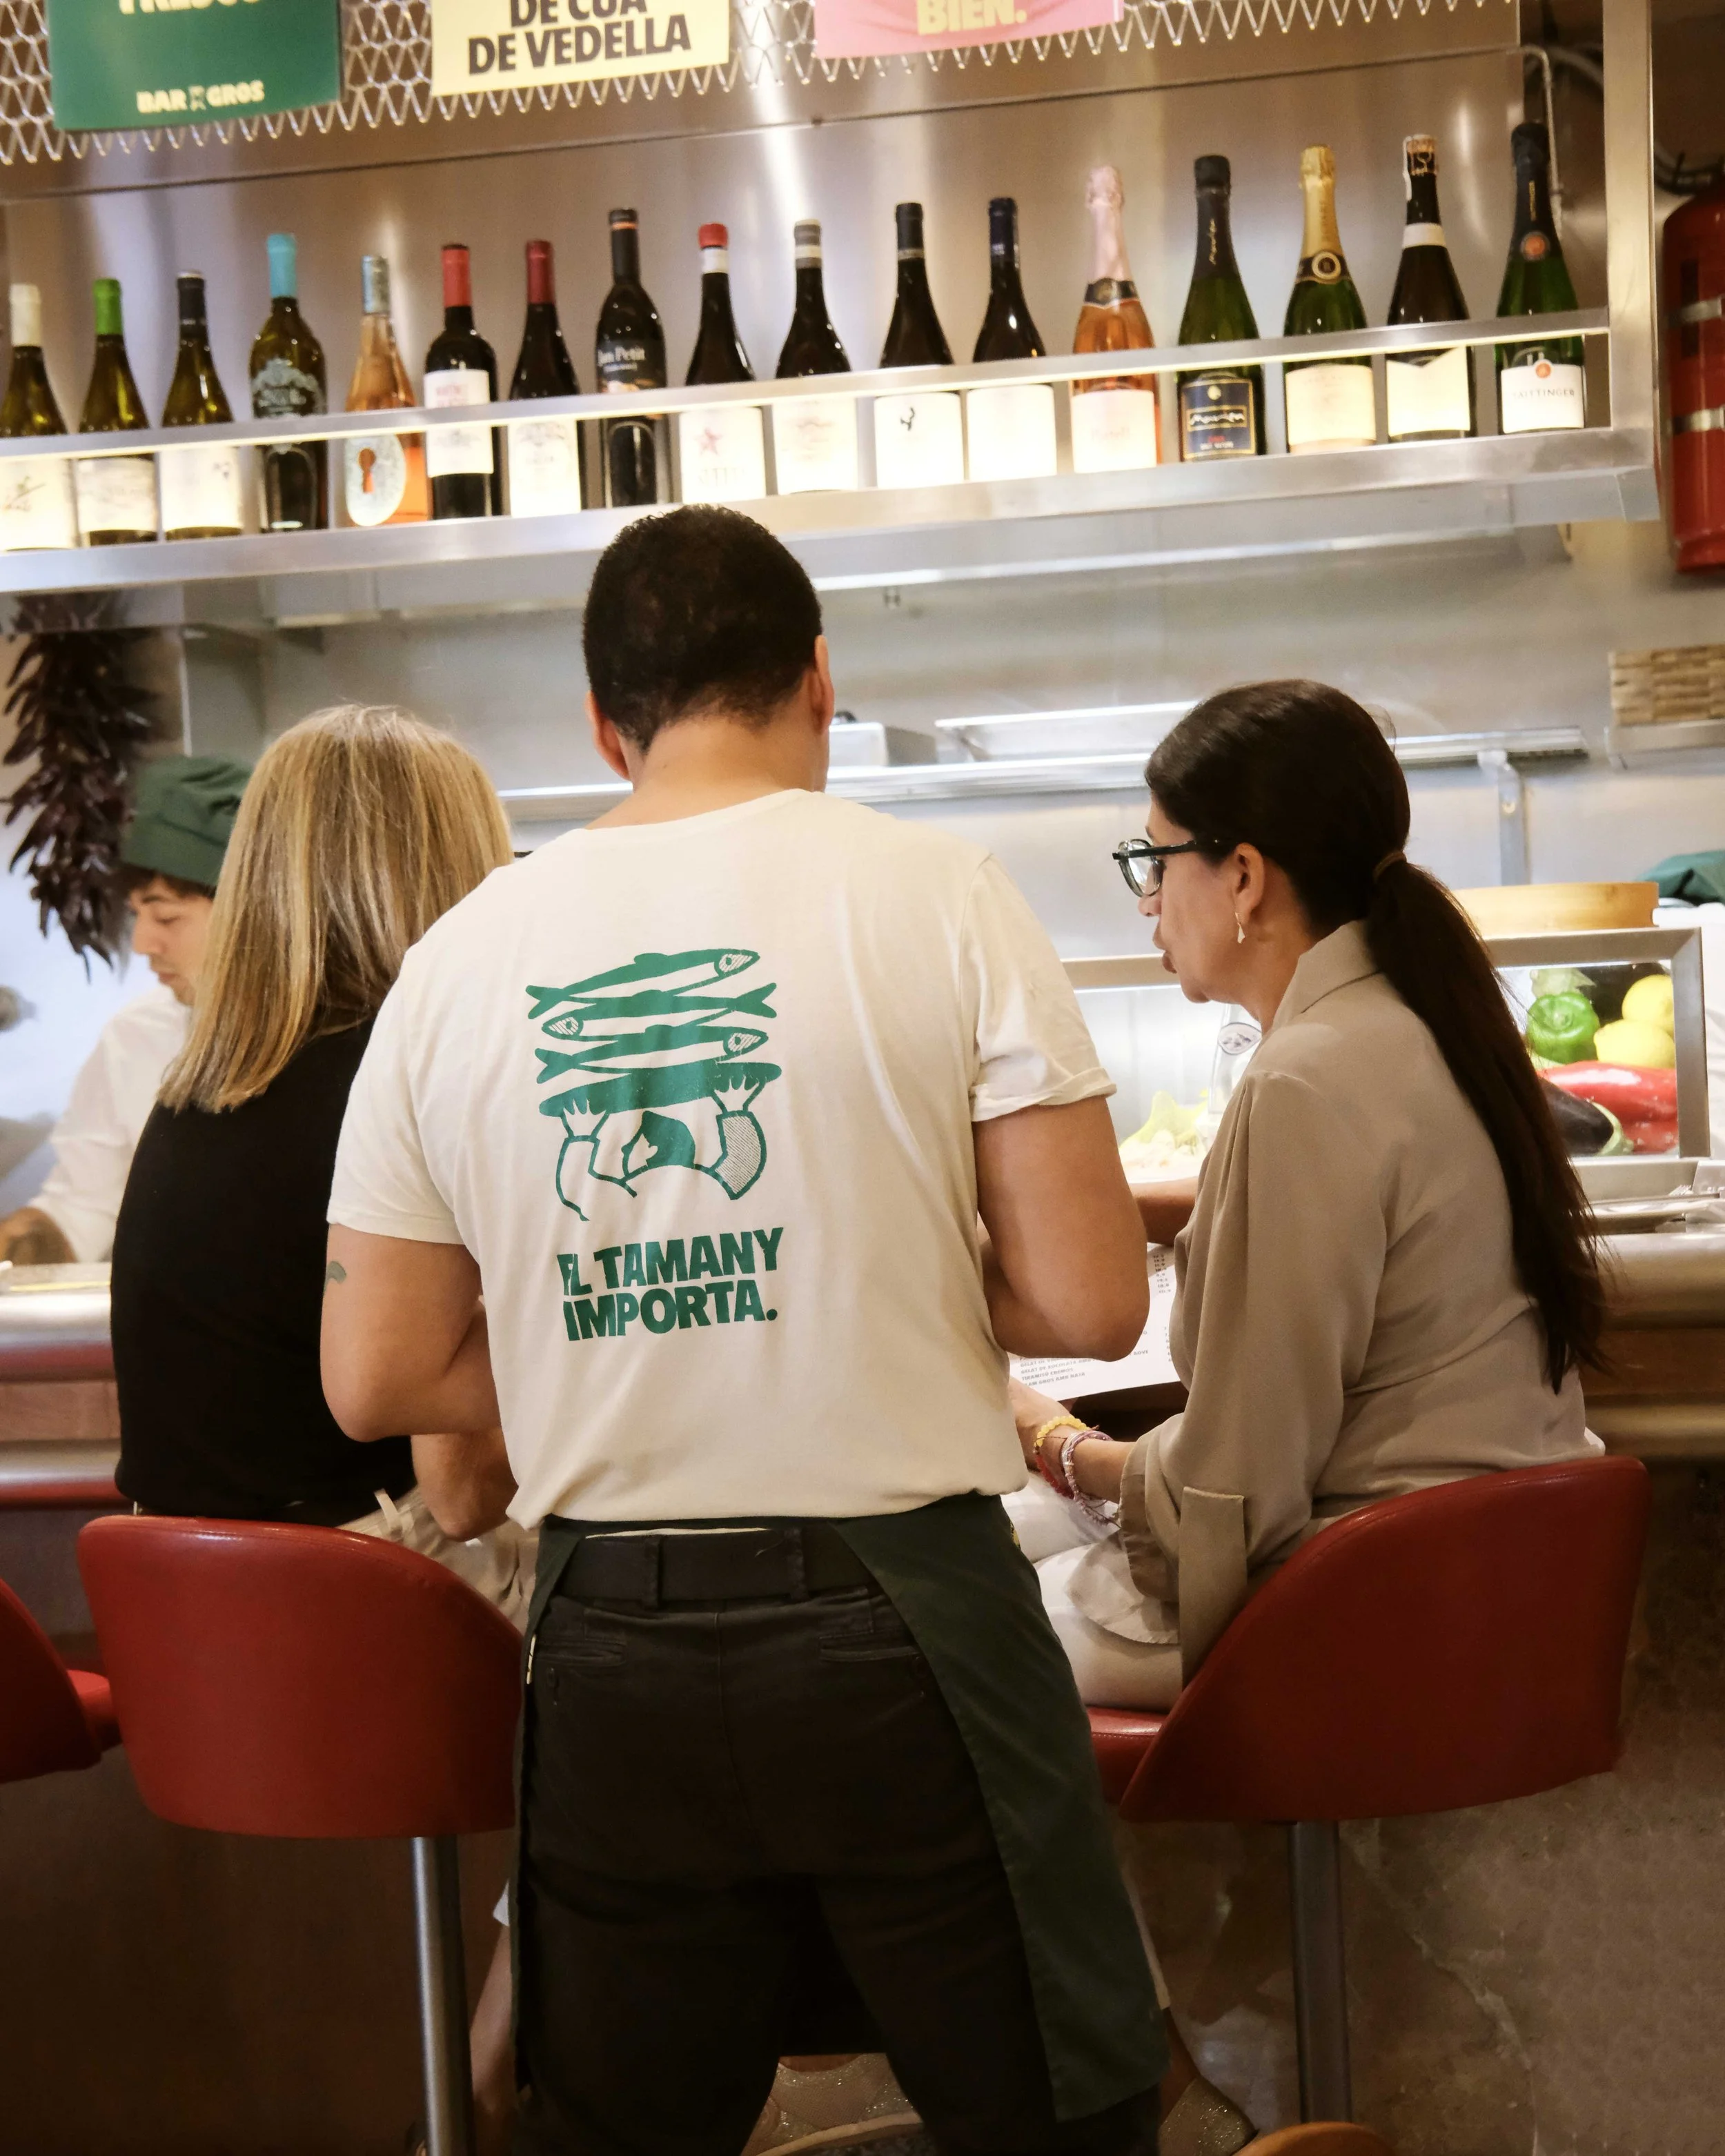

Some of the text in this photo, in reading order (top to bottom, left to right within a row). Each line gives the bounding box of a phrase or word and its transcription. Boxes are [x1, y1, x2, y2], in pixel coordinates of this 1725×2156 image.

[511, 0, 559, 28] DE
[917, 0, 1027, 36] BIEN.
[469, 14, 691, 75] DE VEDELLA
[137, 79, 265, 113] BAR GROS
[593, 1227, 784, 1289] TAMANY
[563, 1279, 778, 1342] IMPORTA.
